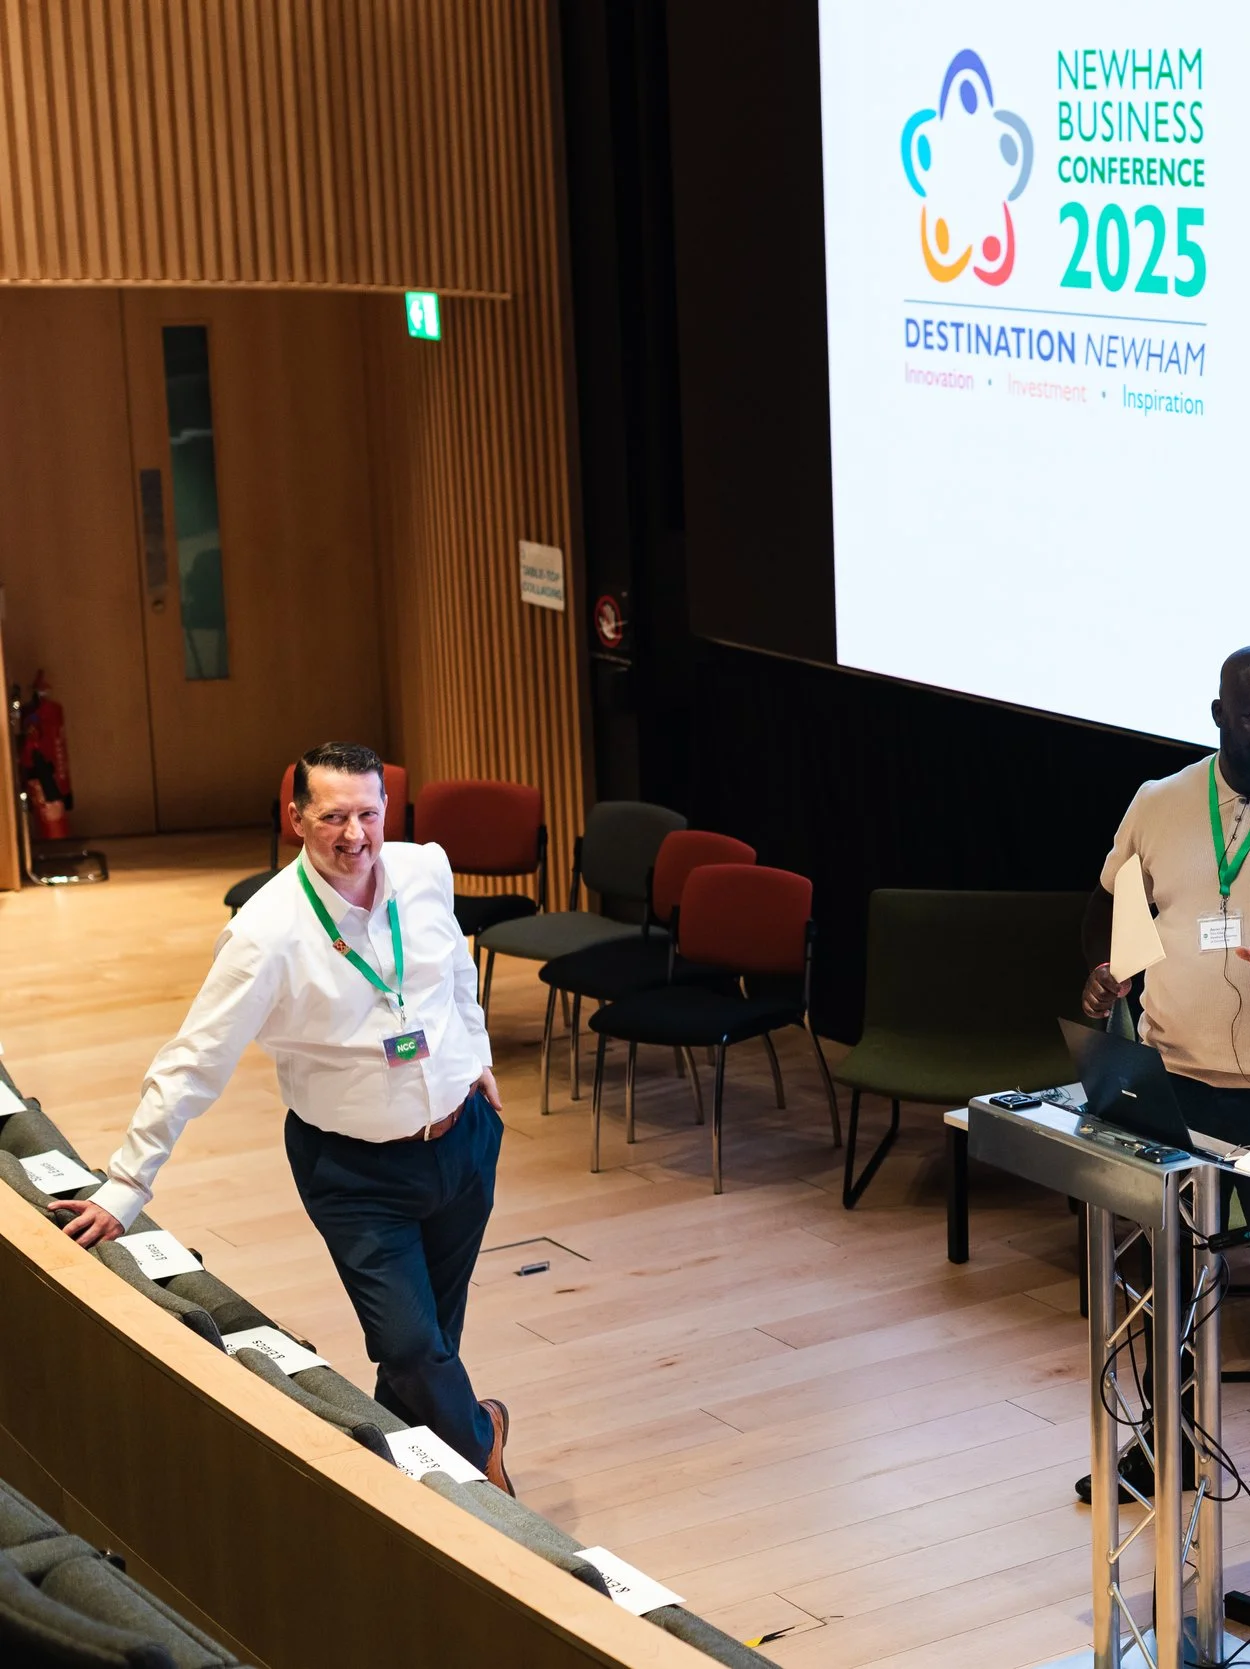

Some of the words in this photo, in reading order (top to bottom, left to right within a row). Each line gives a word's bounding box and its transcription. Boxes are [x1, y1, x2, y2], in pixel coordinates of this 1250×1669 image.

[1058, 48, 1202, 90] NEWHAM
[1059, 101, 1203, 144] BUSINESS
[1058, 156, 1205, 187] CONFERENCE
[1060, 202, 1206, 297] 2025
[905, 318, 1075, 364] DESTINATION
[1085, 334, 1205, 376] NEWHAM
[905, 363, 973, 389] Innovation
[1008, 373, 1087, 403] Investment
[1124, 384, 1203, 416] Inspiration
[397, 1041, 416, 1053] NCC
